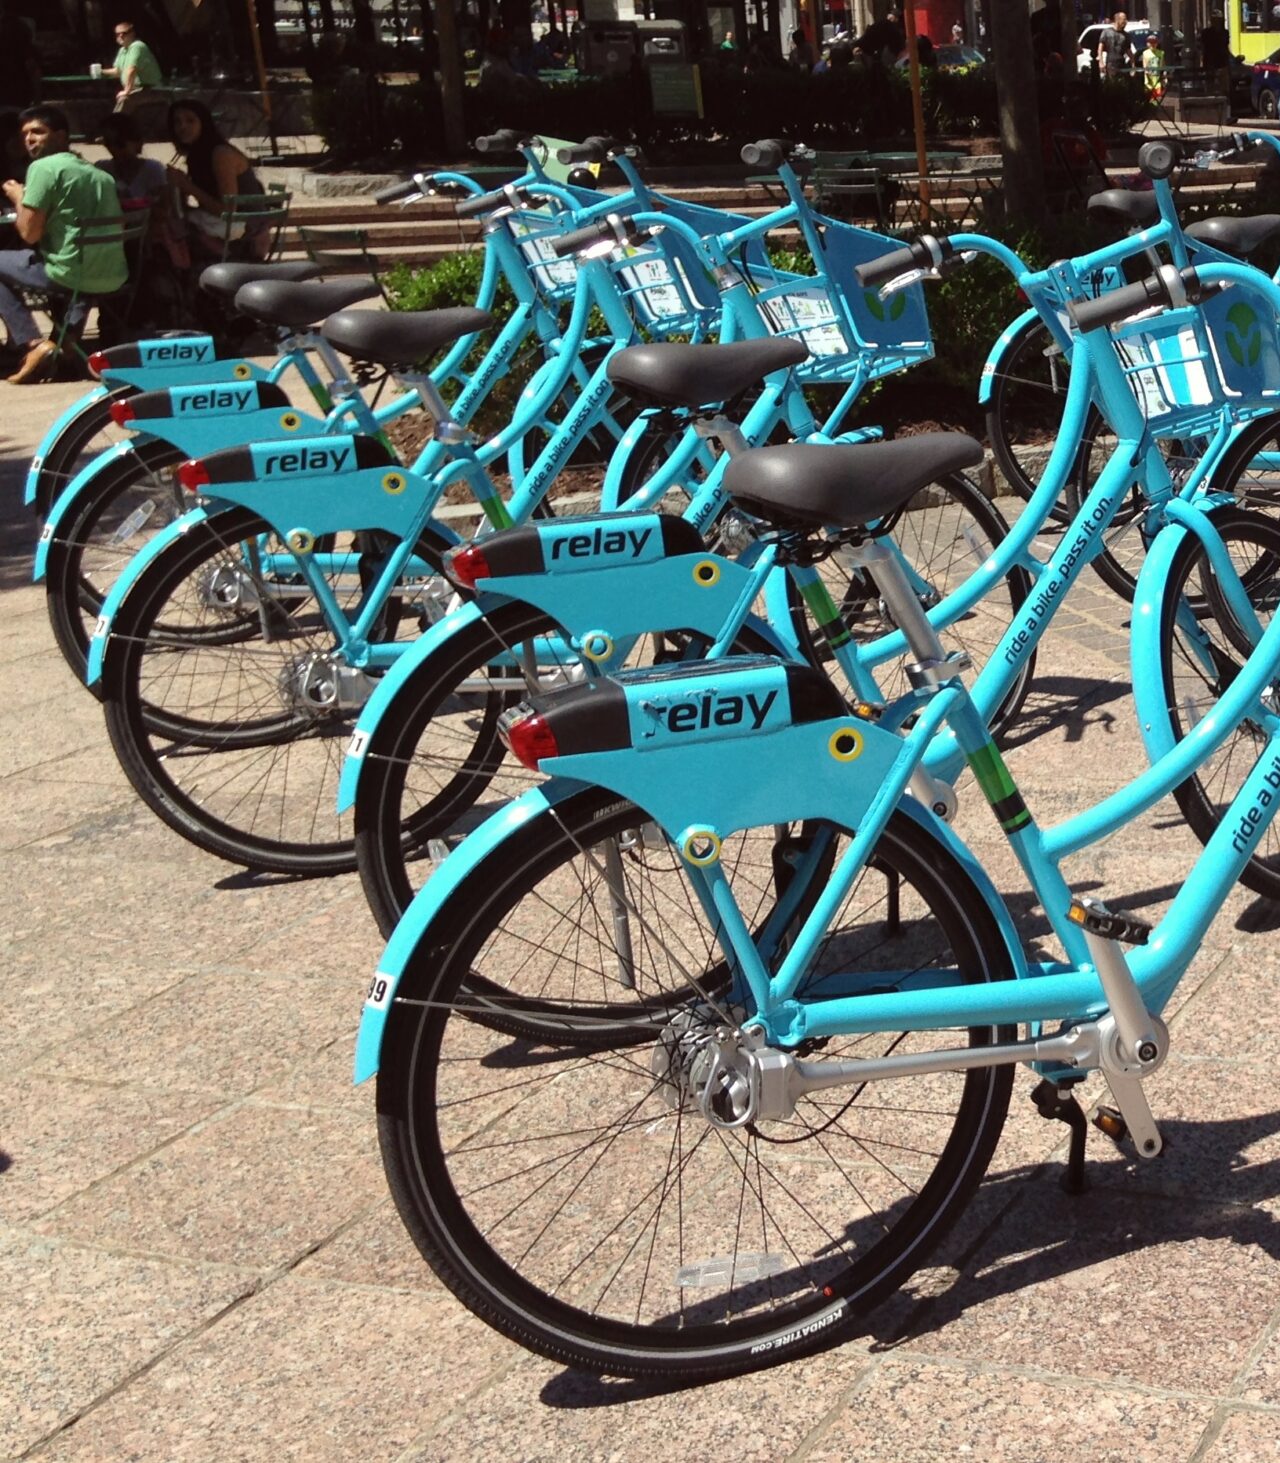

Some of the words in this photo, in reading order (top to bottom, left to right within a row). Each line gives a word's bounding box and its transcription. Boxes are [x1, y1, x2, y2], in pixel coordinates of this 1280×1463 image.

[147, 343, 209, 361] relay
[477, 363, 496, 388] pass
[492, 352, 502, 362] it
[180, 389, 253, 412] relay
[585, 394, 597, 405] it
[568, 407, 589, 436] pass
[265, 448, 350, 475] relay
[547, 436, 571, 462] bike.
[543, 462, 552, 471] a
[528, 472, 545, 495] ride
[551, 527, 652, 560] relay
[1005, 630, 1029, 664] ride
[1025, 617, 1036, 630] a
[1031, 580, 1061, 616] bike.
[1058, 535, 1086, 578] pass
[1080, 520, 1095, 536] it
[1092, 497, 1112, 520] on.
[1232, 807, 1261, 852] ride
[1256, 789, 1271, 806] a
[751, 1309, 843, 1354] KENDATIRE.COM
